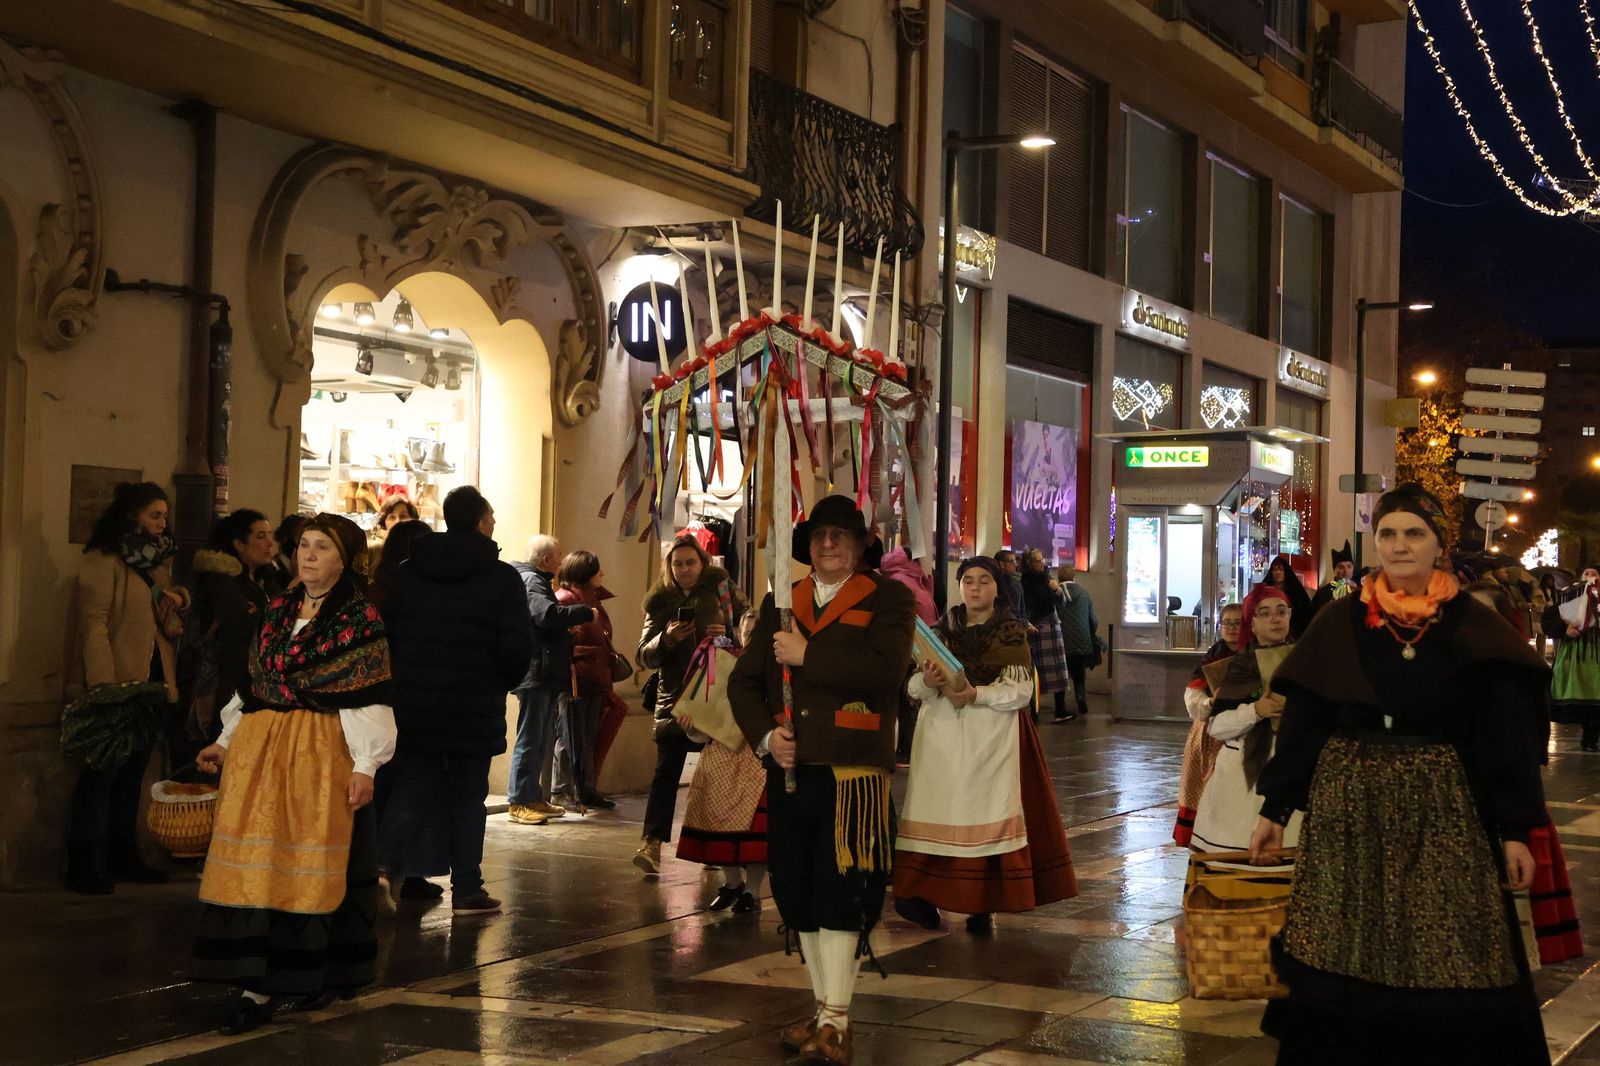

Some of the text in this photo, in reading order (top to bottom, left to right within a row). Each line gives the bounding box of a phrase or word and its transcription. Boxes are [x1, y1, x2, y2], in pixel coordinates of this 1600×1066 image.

[631, 300, 671, 342] IN
[1150, 451, 1201, 463] ONCE
[1015, 483, 1071, 515] VUELTAS
